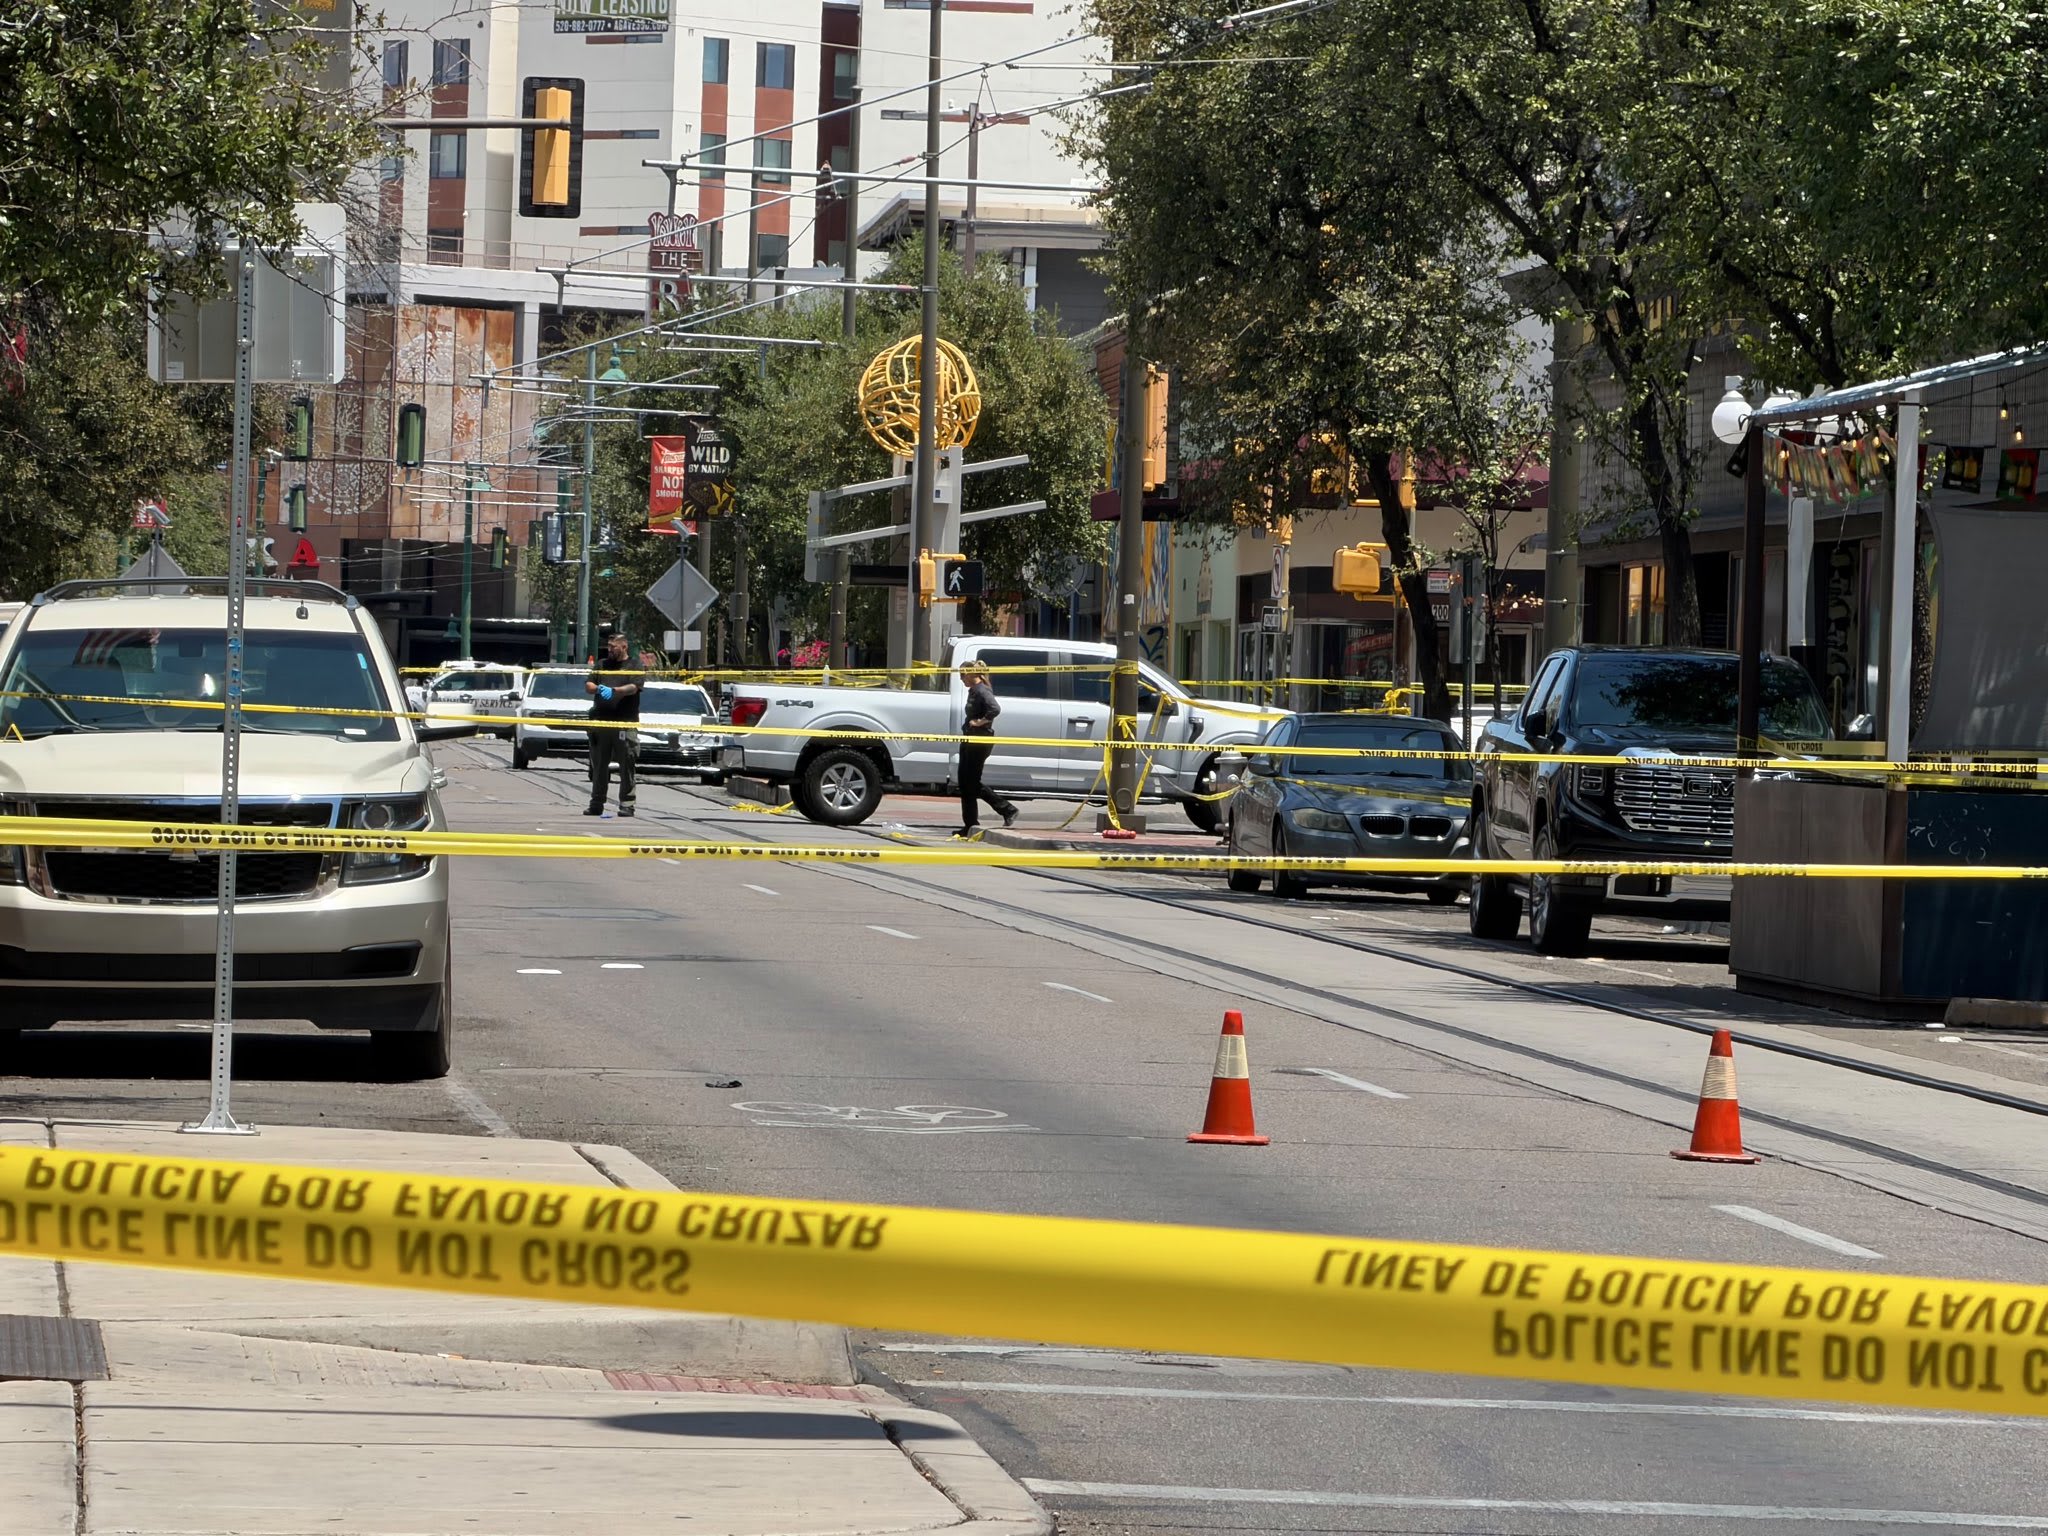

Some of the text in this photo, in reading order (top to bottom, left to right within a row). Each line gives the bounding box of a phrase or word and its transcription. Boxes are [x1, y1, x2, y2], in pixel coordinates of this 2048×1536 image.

[600, 0, 669, 15] LEASING
[660, 252, 688, 267] THE
[690, 445, 730, 464] WILD
[688, 464, 699, 473] BY
[480, 698, 513, 709] SERVICE
